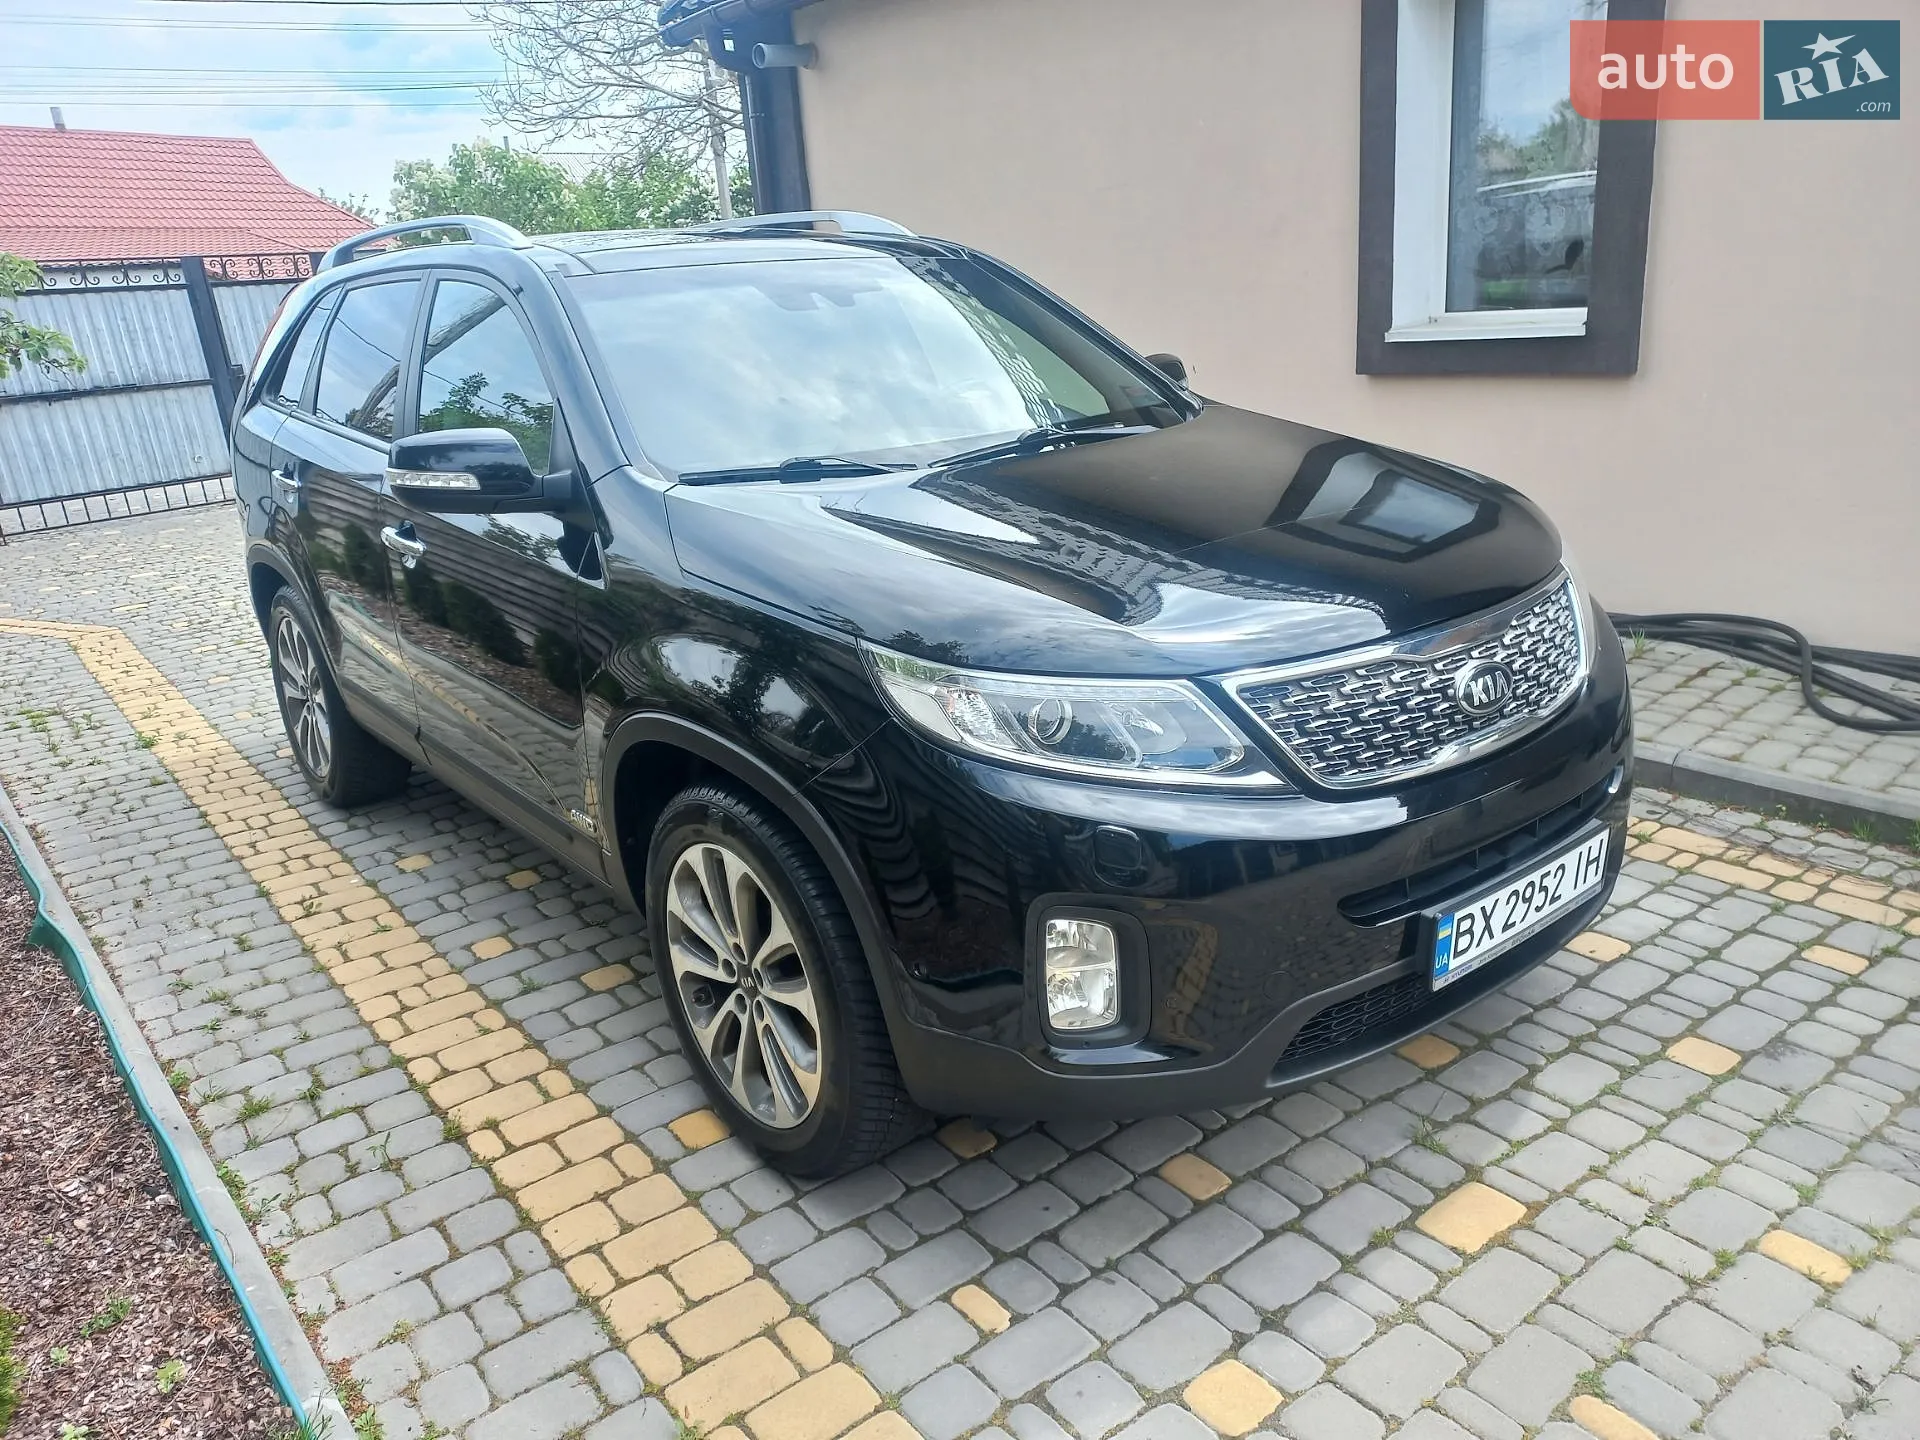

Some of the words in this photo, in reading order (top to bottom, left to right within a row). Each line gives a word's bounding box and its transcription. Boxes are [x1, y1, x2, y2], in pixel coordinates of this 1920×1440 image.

[1468, 670, 1509, 707] KIA
[1453, 898, 1499, 960] BX
[1502, 863, 1566, 933] 2952
[1574, 838, 1604, 890] IH
[1435, 952, 1449, 969] UA
